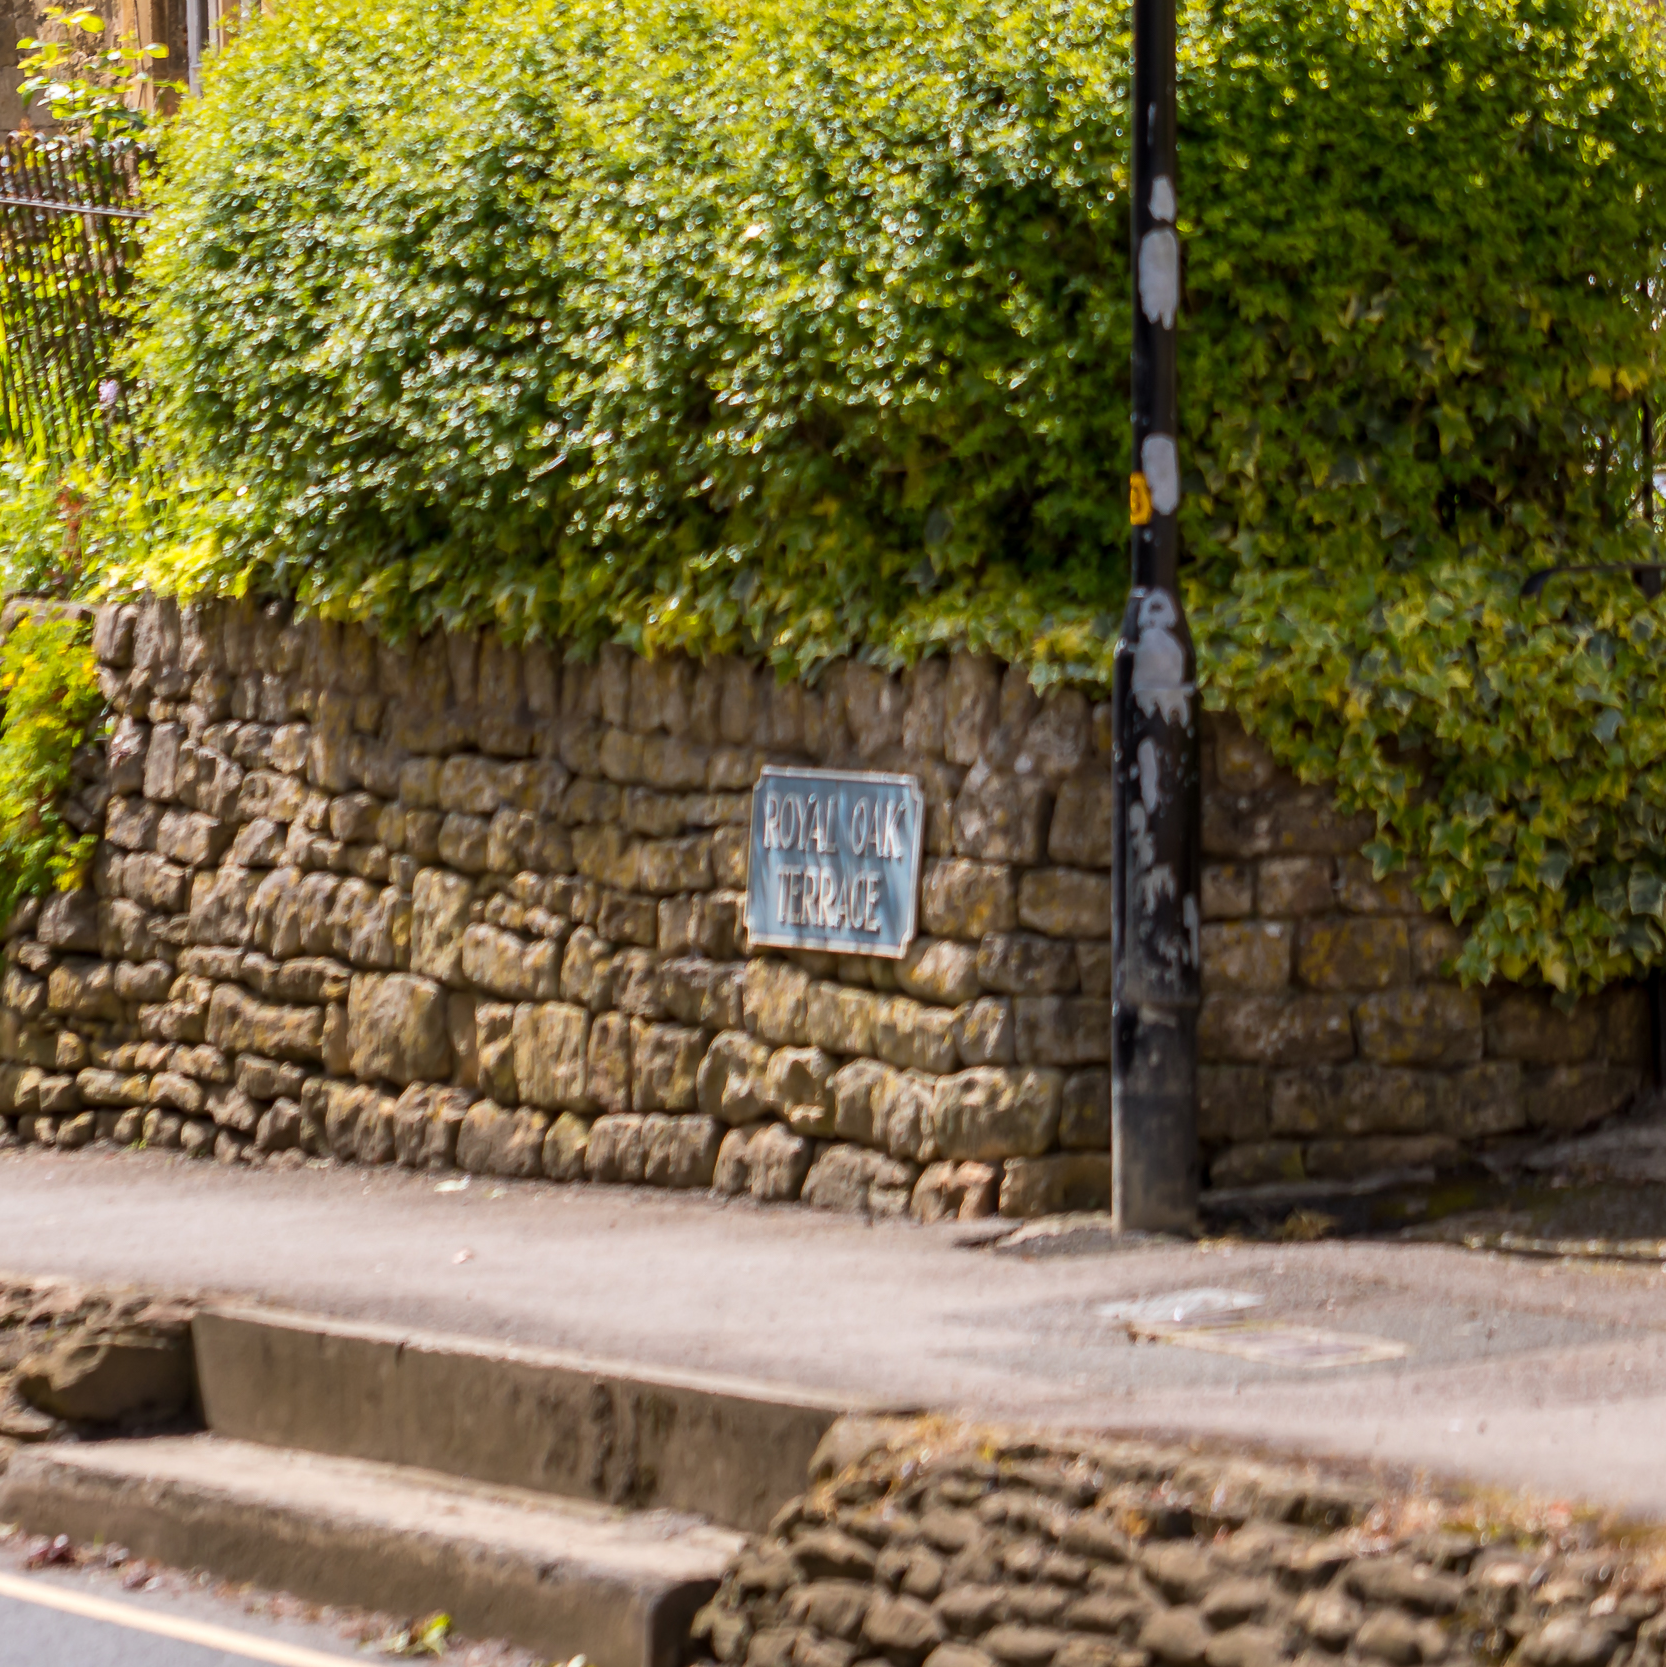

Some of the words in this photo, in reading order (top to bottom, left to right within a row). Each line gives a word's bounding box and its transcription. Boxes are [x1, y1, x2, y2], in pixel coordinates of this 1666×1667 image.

[763, 790, 838, 853] ROYAL
[851, 796, 908, 859] OAK
[776, 864, 882, 932] TERRACE
